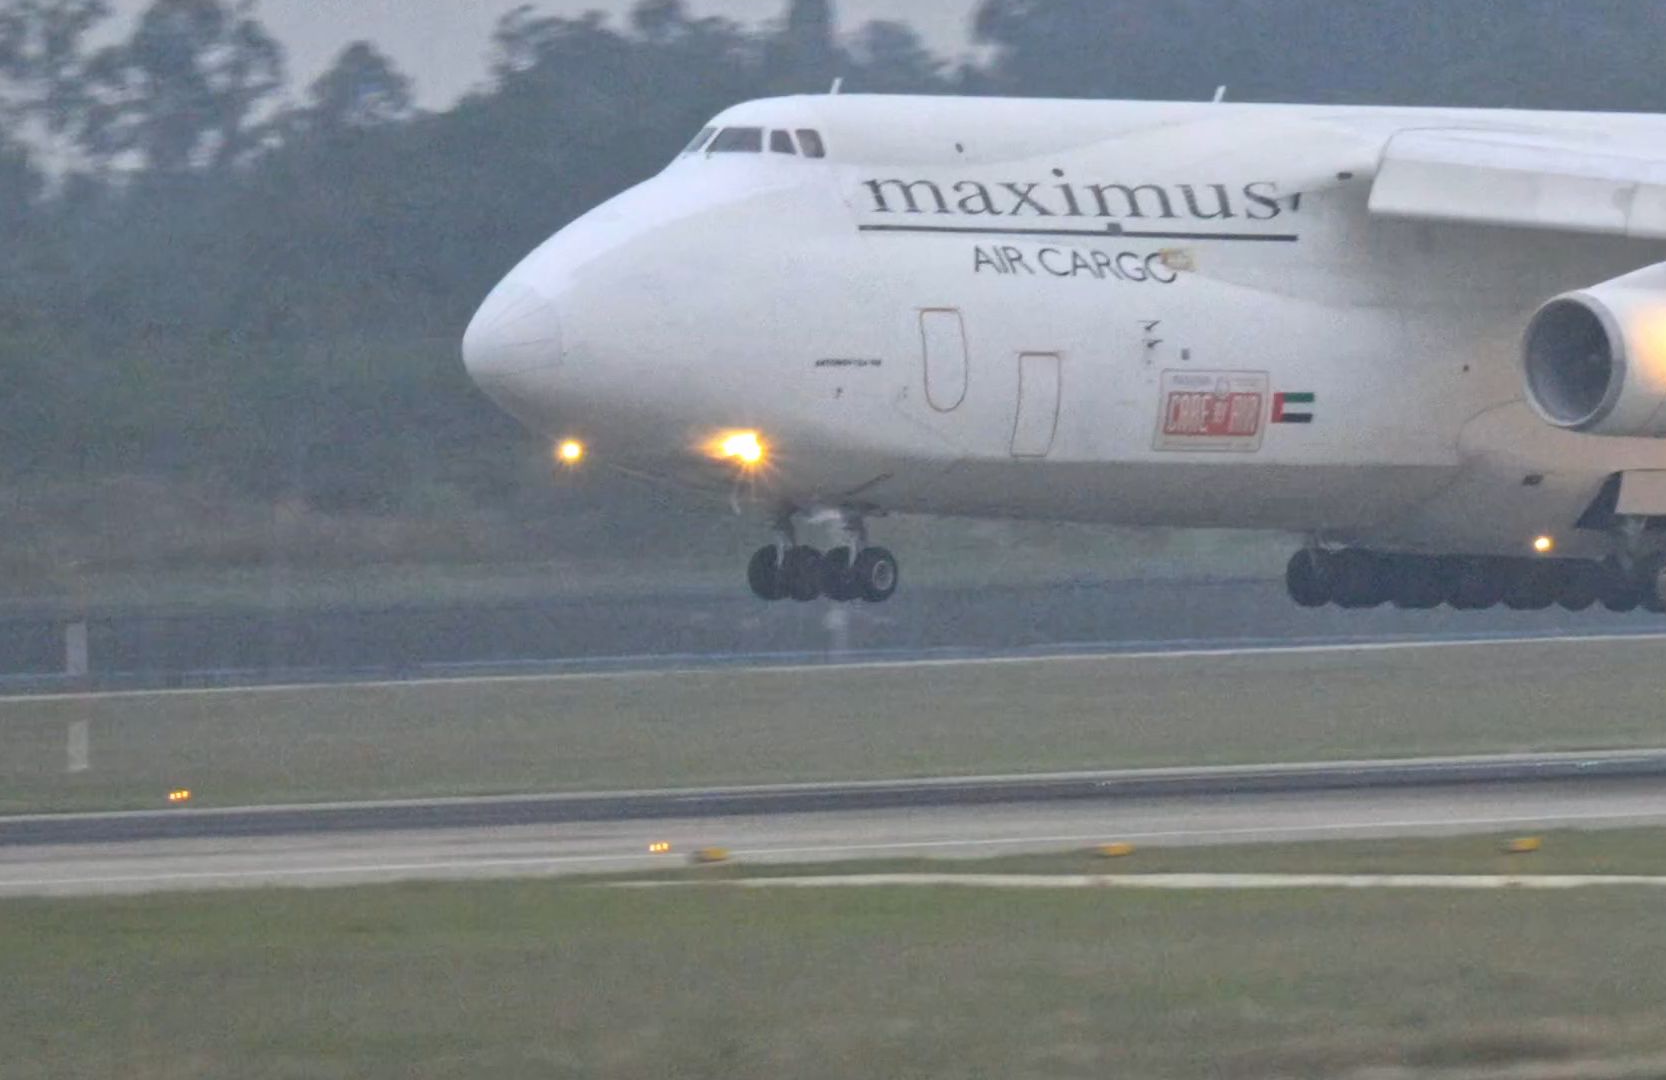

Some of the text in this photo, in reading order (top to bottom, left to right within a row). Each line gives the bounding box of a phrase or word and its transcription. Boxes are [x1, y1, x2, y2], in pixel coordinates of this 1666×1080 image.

[862, 167, 1281, 220] maximus
[974, 245, 1178, 284] AIR CARGO
